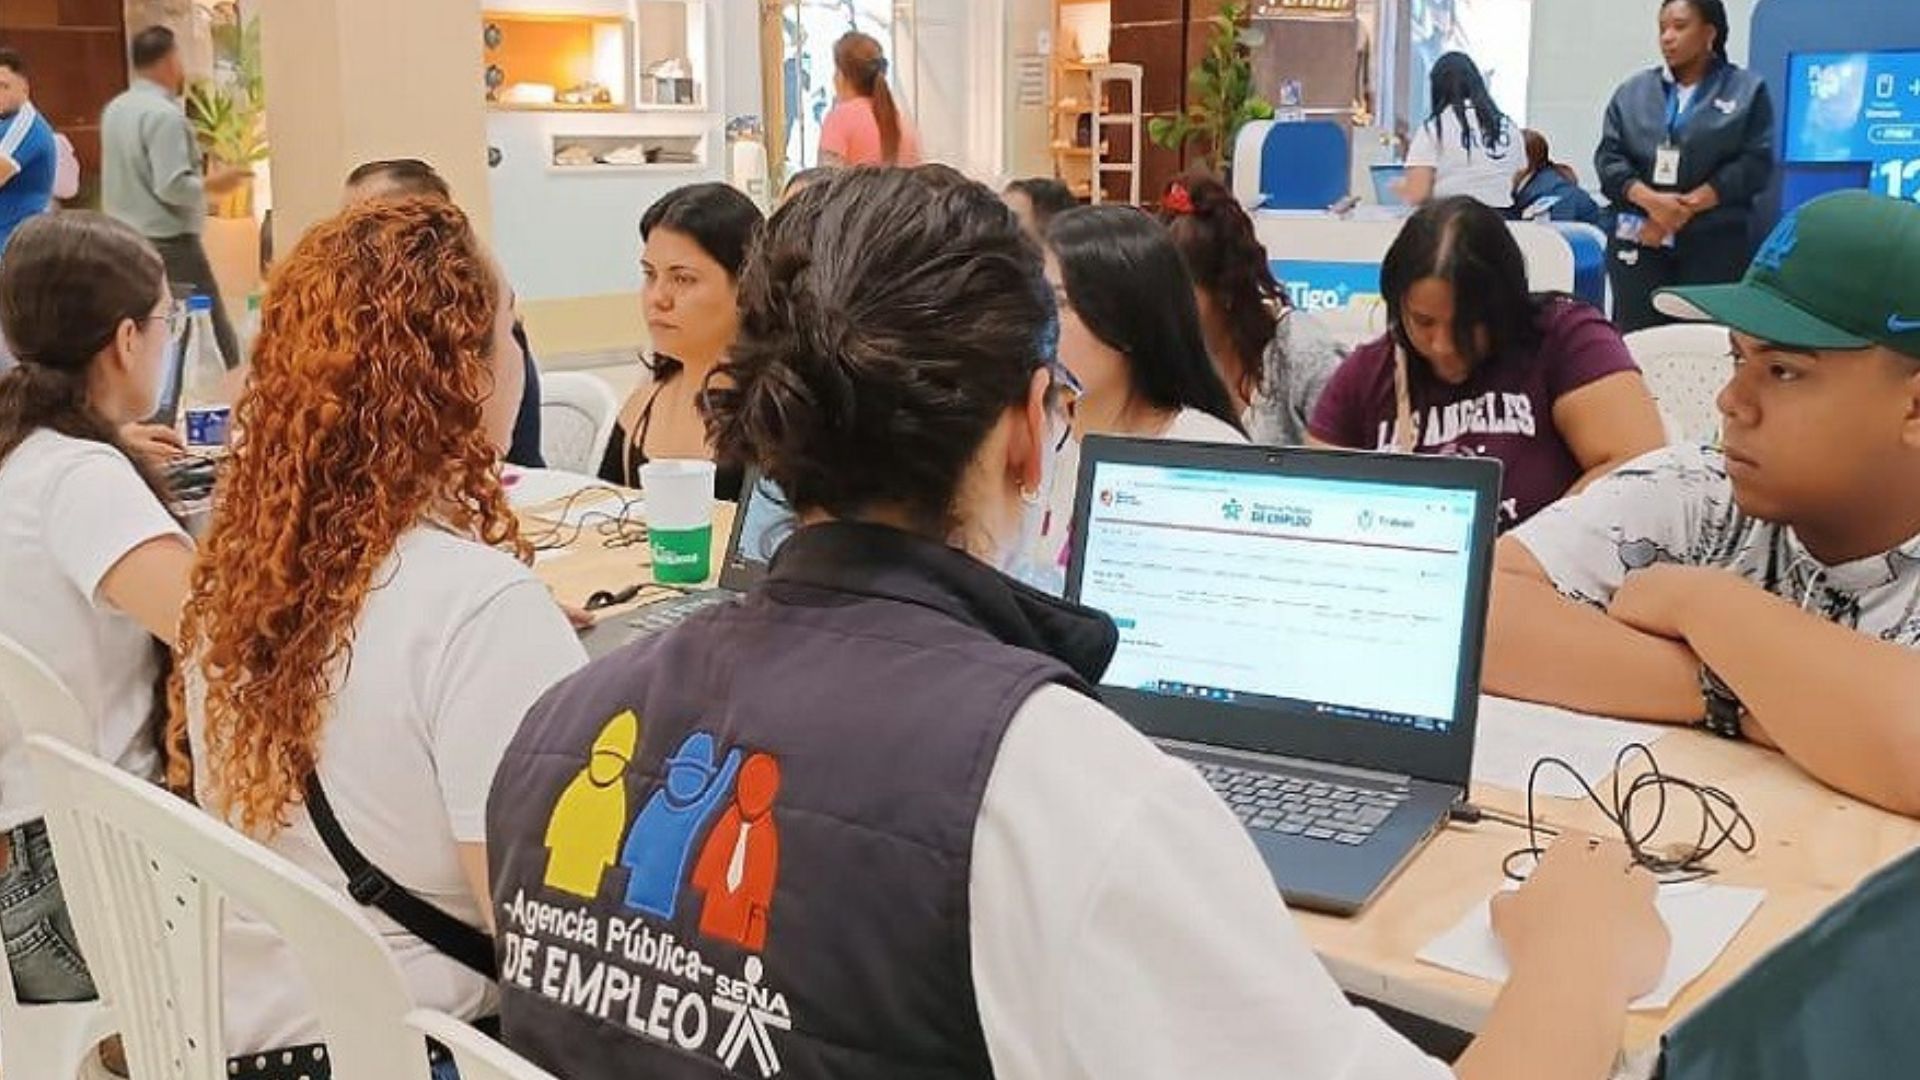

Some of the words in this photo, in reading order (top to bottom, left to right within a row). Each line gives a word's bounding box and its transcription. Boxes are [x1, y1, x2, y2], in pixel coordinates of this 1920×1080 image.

[1285, 281, 1339, 313] Tigo
[1423, 391, 1536, 447] ANGELES
[503, 932, 540, 988] DE
[541, 945, 709, 1050] EMPLEO
[715, 974, 790, 1017] SENA
